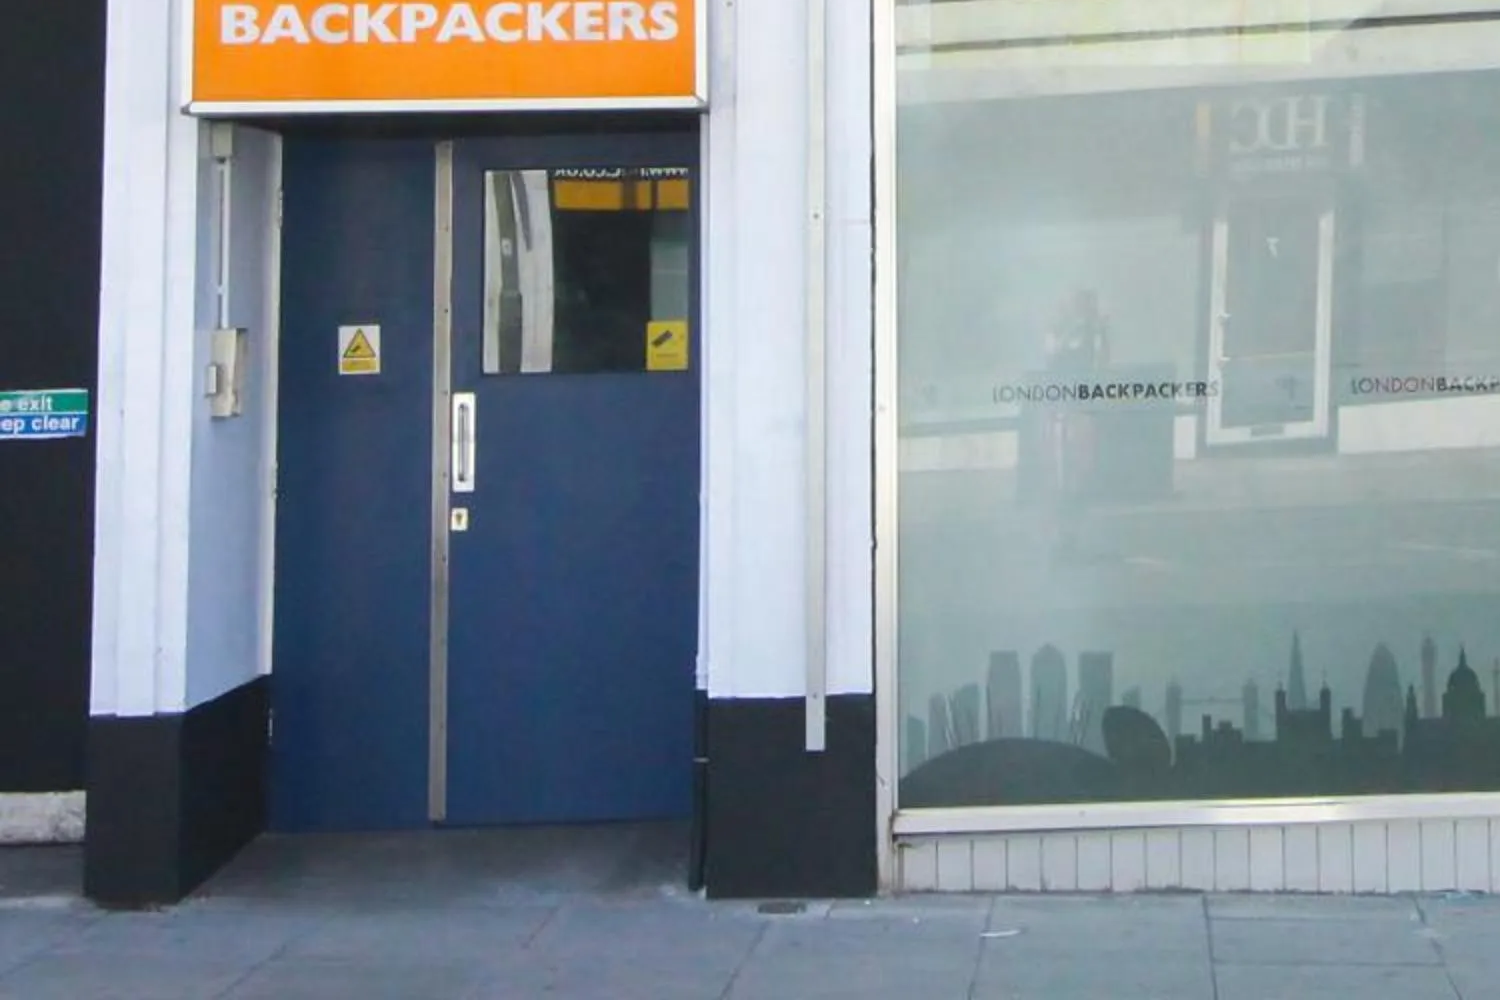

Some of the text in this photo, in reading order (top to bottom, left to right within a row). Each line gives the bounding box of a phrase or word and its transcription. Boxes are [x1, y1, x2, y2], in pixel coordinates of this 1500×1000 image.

[219, 0, 680, 46] BACKPACKERS
[18, 396, 53, 410] exit
[0, 415, 79, 435] ep clear
